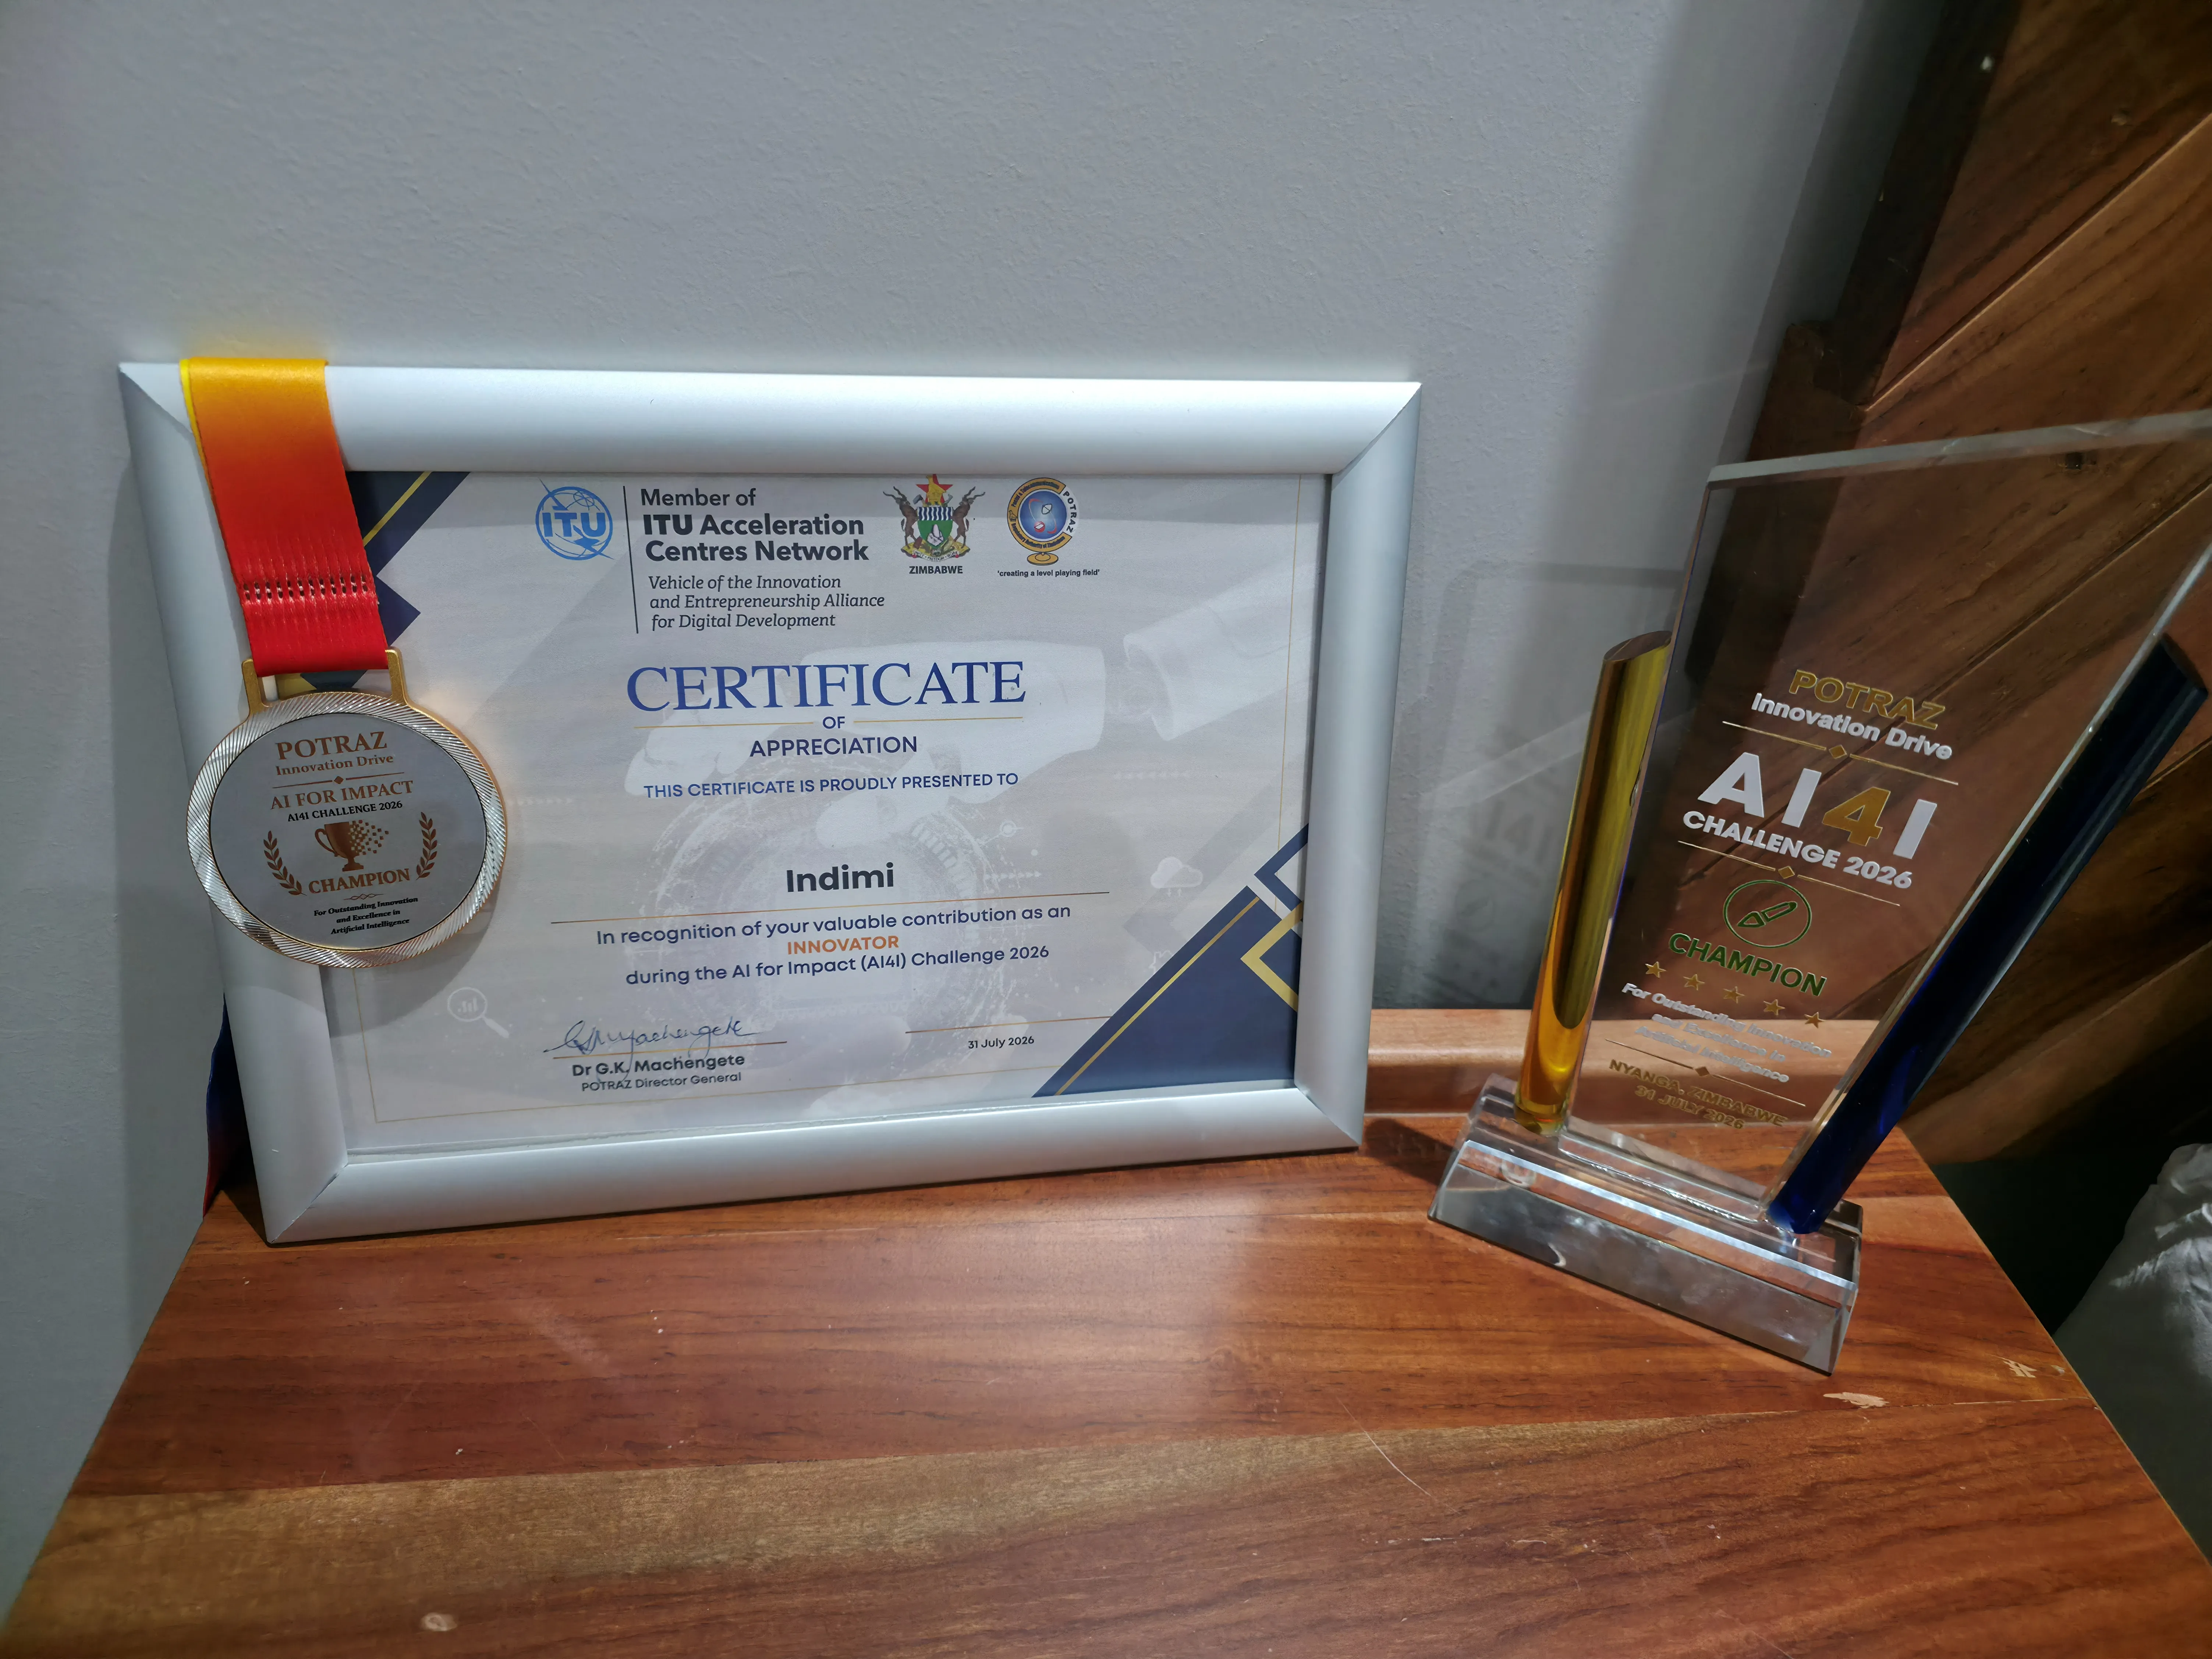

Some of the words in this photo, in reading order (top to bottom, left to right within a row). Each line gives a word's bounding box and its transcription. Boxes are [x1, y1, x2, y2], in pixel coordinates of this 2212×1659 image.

[641, 488, 731, 506] Member
[736, 488, 756, 506] of
[1063, 491, 1077, 533] POTRAZ
[543, 512, 607, 537] ITU
[644, 515, 692, 535] ITU
[700, 514, 863, 535] Acceleration
[645, 540, 747, 562] Centres
[756, 539, 868, 561] Network
[909, 566, 963, 574] ZIMBABWE
[649, 575, 704, 589] Vehicle
[708, 575, 724, 592] of
[727, 575, 752, 589] the
[757, 575, 840, 589] Innovation
[650, 595, 680, 609] and
[685, 595, 819, 611] Entrepreneurship
[823, 594, 884, 607] Alliance
[652, 615, 674, 631] for
[680, 614, 731, 631] Digital
[736, 613, 835, 630] Development
[627, 662, 1026, 712] CERTIFICATE
[1789, 669, 1946, 730] POTRAZ
[823, 716, 845, 730] OF
[1751, 693, 1880, 742] Innovation
[1885, 727, 1953, 760] Drive
[275, 731, 387, 760] POTRAZ
[749, 736, 917, 757] APPRECIATION
[276, 760, 353, 775] Innovation
[357, 755, 393, 766] Drive
[270, 795, 291, 809] AI
[295, 790, 337, 807] FOR
[341, 780, 413, 801] IMPACT
[644, 784, 683, 798] THIS
[687, 780, 795, 797] CERTIFICATE
[800, 780, 815, 792] IS
[820, 777, 897, 791] PROUDLY
[903, 774, 993, 788] PRESENTED
[996, 773, 1018, 785] TO
[312, 804, 377, 819] CHALLENGE
[379, 800, 403, 810] 2026
[1697, 752, 1938, 859] AI4I
[1683, 811, 1841, 869] CHALLENGE
[1843, 856, 1912, 889] 2026
[308, 868, 411, 894] CHAMPION
[786, 862, 894, 892] Indimi
[328, 903, 376, 914] Outstanding
[377, 897, 418, 907] Innovation
[352, 912, 391, 921] Excellence
[331, 924, 365, 935] Artificial
[366, 919, 410, 929] Intelligence
[598, 930, 614, 944] In
[621, 924, 735, 944] recognition
[741, 921, 762, 936] of
[765, 922, 809, 938] your
[814, 914, 897, 932] valuable
[902, 908, 1015, 927] contribution
[1021, 908, 1042, 919] as
[1047, 905, 1070, 918] an
[787, 935, 899, 954] INNOVATOR
[626, 969, 690, 985] during
[695, 965, 727, 981] the
[732, 964, 750, 978] AI
[755, 962, 783, 976] for
[788, 958, 856, 976] Impact
[861, 953, 906, 972] (AI4I)
[911, 948, 1005, 966] Challenge
[1010, 945, 1049, 960] 2026
[1669, 933, 1827, 997] CHAMPION
[1621, 983, 1652, 999] For
[1652, 993, 1746, 1031] Outstanding
[1747, 1023, 1832, 1058] Innovation
[1652, 1014, 1684, 1029] and
[968, 1041, 978, 1049] 31
[981, 1038, 1005, 1049] July
[1008, 1036, 1035, 1046] 2026
[573, 1064, 592, 1076] Dr
[634, 1054, 745, 1073] Machengete
[582, 1079, 632, 1092] POTRAZ
[635, 1077, 687, 1088] Director
[690, 1072, 741, 1084] General
[1634, 1085, 1656, 1100] 31
[1658, 1094, 1705, 1115] JULY
[1703, 1108, 1746, 1130] 2026
[1687, 1085, 1788, 1127] ZIMBABWE
